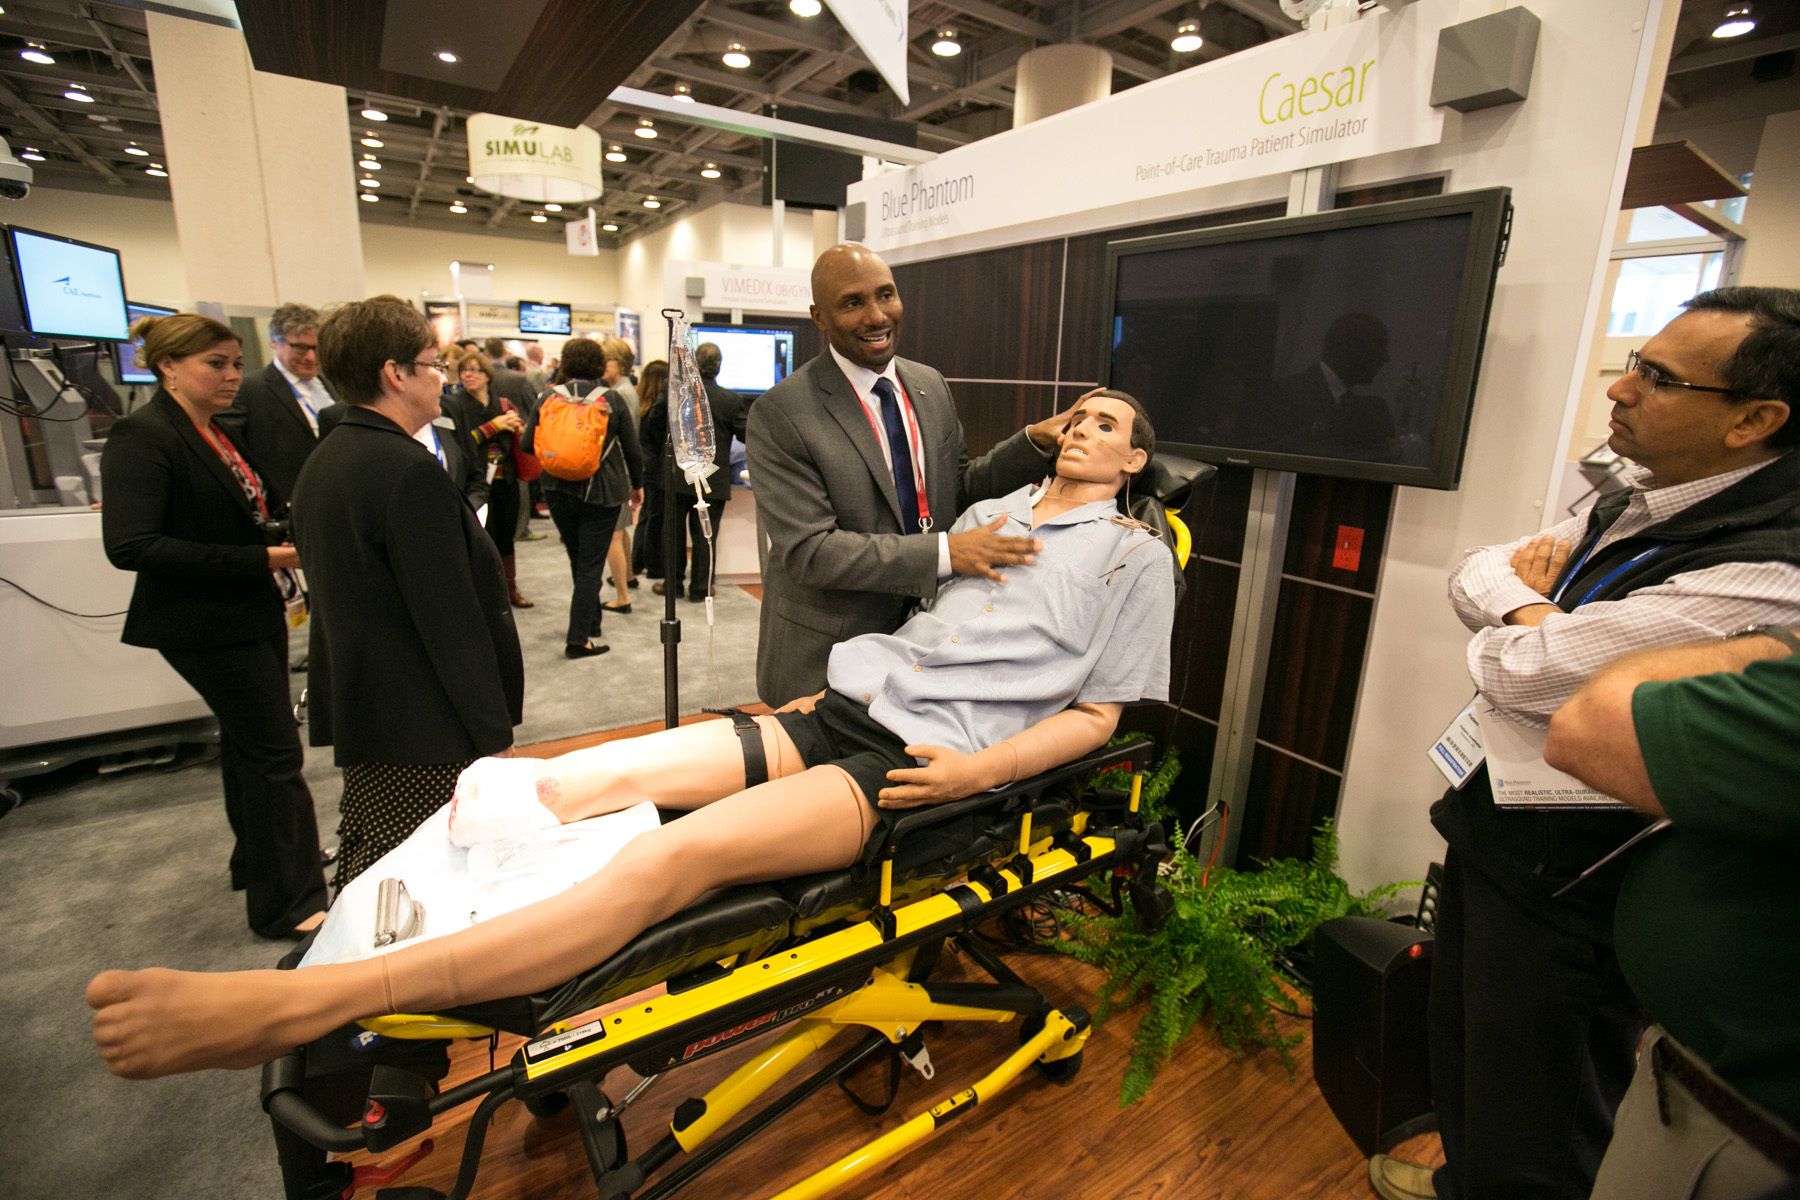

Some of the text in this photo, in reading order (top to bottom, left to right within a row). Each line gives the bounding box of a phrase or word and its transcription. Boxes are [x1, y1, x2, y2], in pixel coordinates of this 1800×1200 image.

[1259, 59, 1375, 125] Caesar
[485, 140, 573, 162] SIMULAB
[1135, 115, 1369, 182] Point-of-Care Trauma Patient Simulator
[882, 174, 974, 221] Blue Phantom
[722, 278, 773, 296] VIMEDIX
